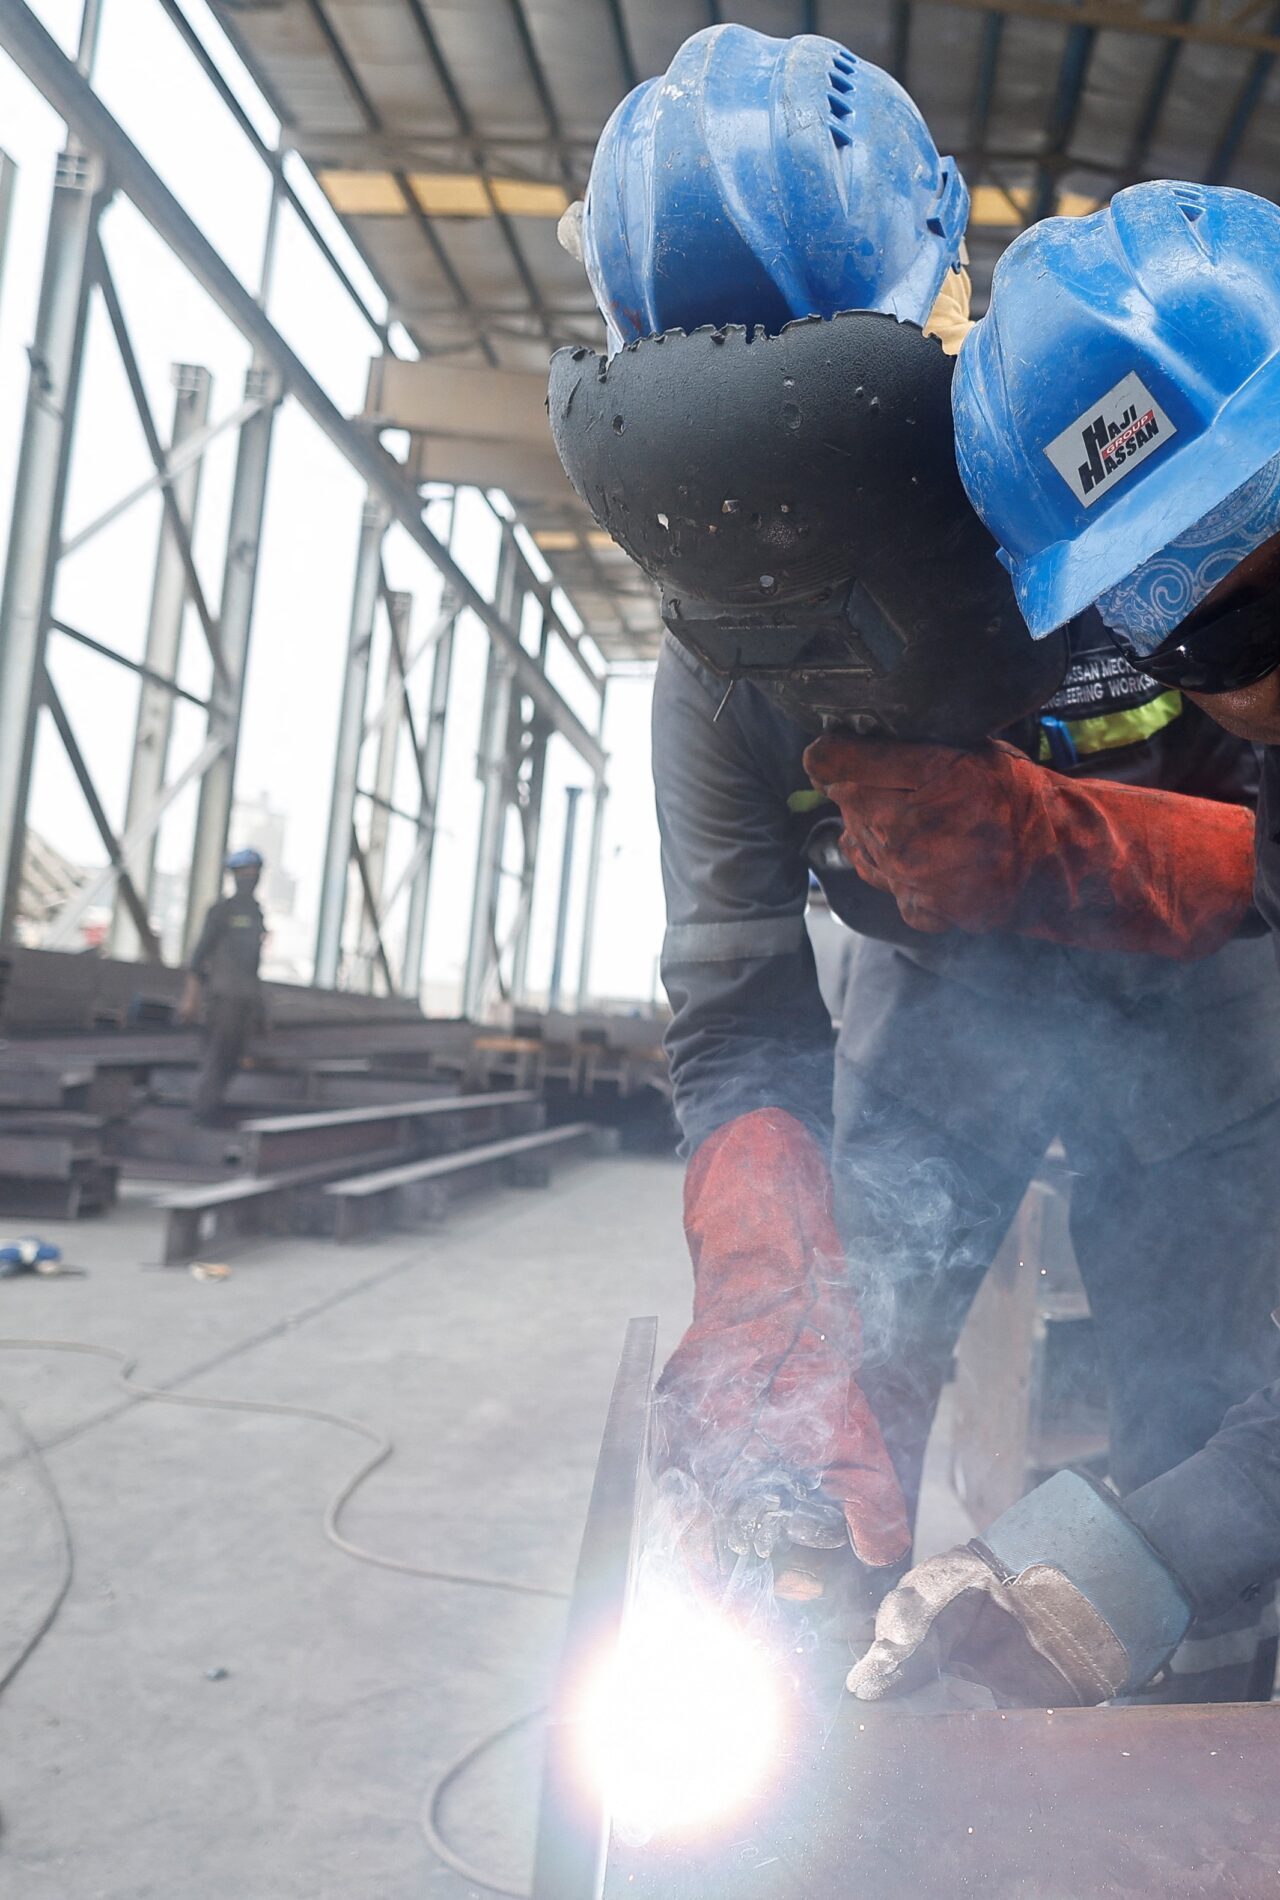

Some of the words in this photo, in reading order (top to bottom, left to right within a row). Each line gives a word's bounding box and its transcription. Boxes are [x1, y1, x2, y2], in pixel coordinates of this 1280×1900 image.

[1081, 404, 1138, 450] HAJI
[1105, 414, 1150, 454] GROUP
[1077, 417, 1160, 495] HASSAN
